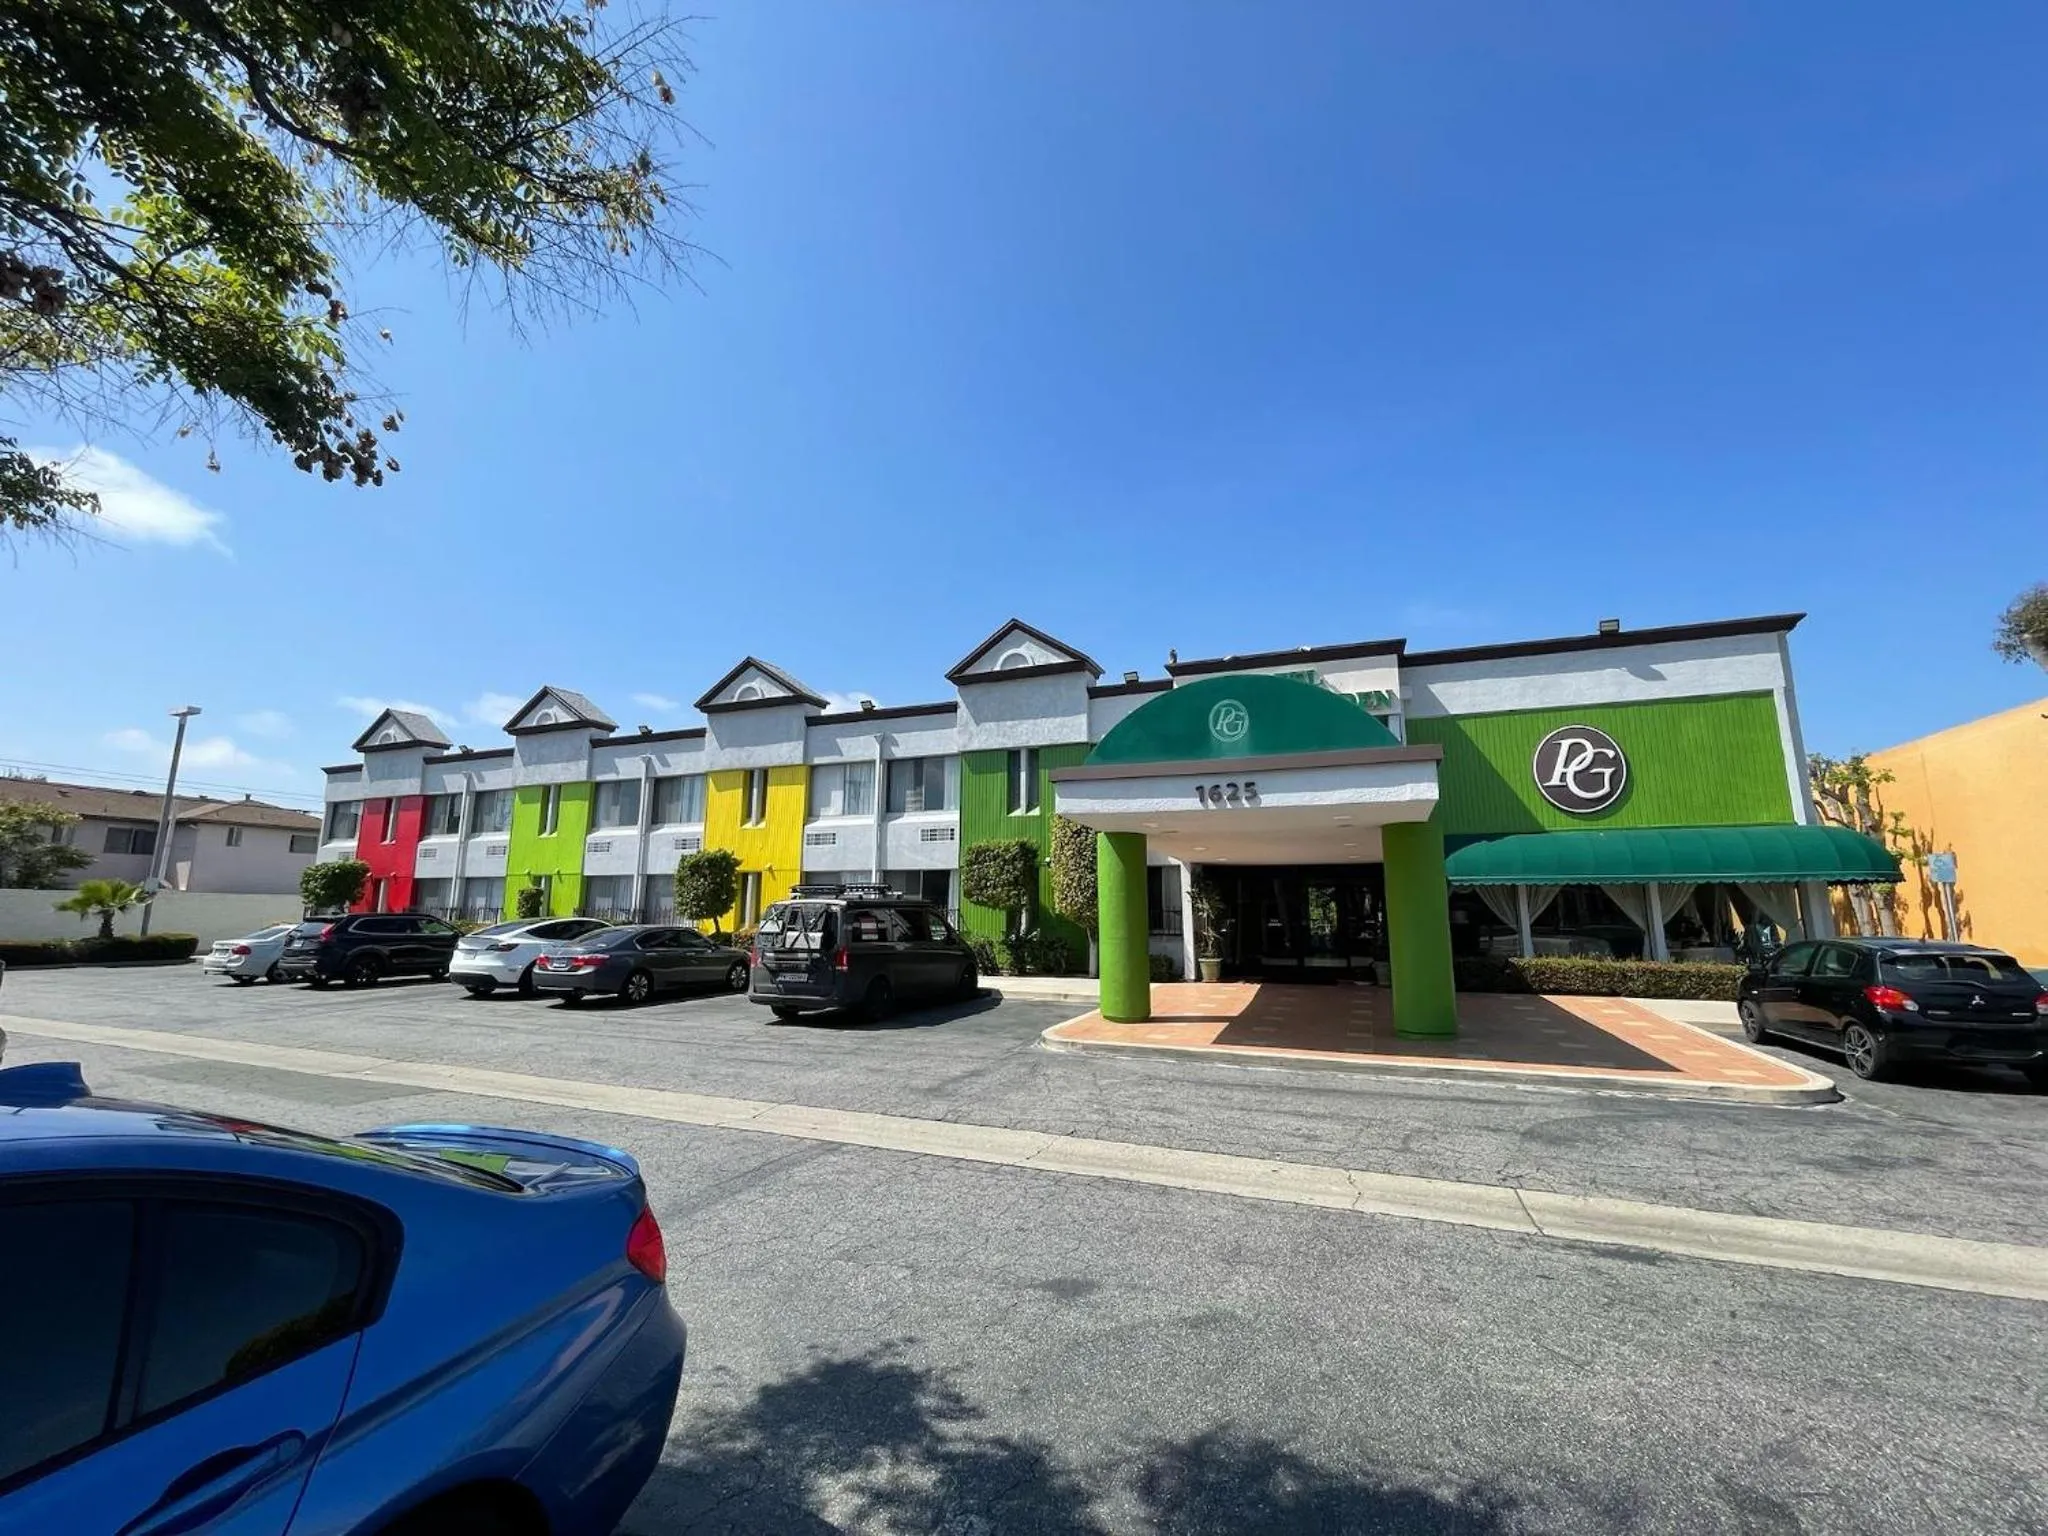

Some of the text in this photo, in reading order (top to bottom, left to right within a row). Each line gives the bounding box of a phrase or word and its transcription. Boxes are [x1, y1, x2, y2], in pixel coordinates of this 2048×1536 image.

[1215, 706, 1245, 735] PG
[1542, 738, 1616, 799] PG
[1195, 781, 1258, 803] 1625
